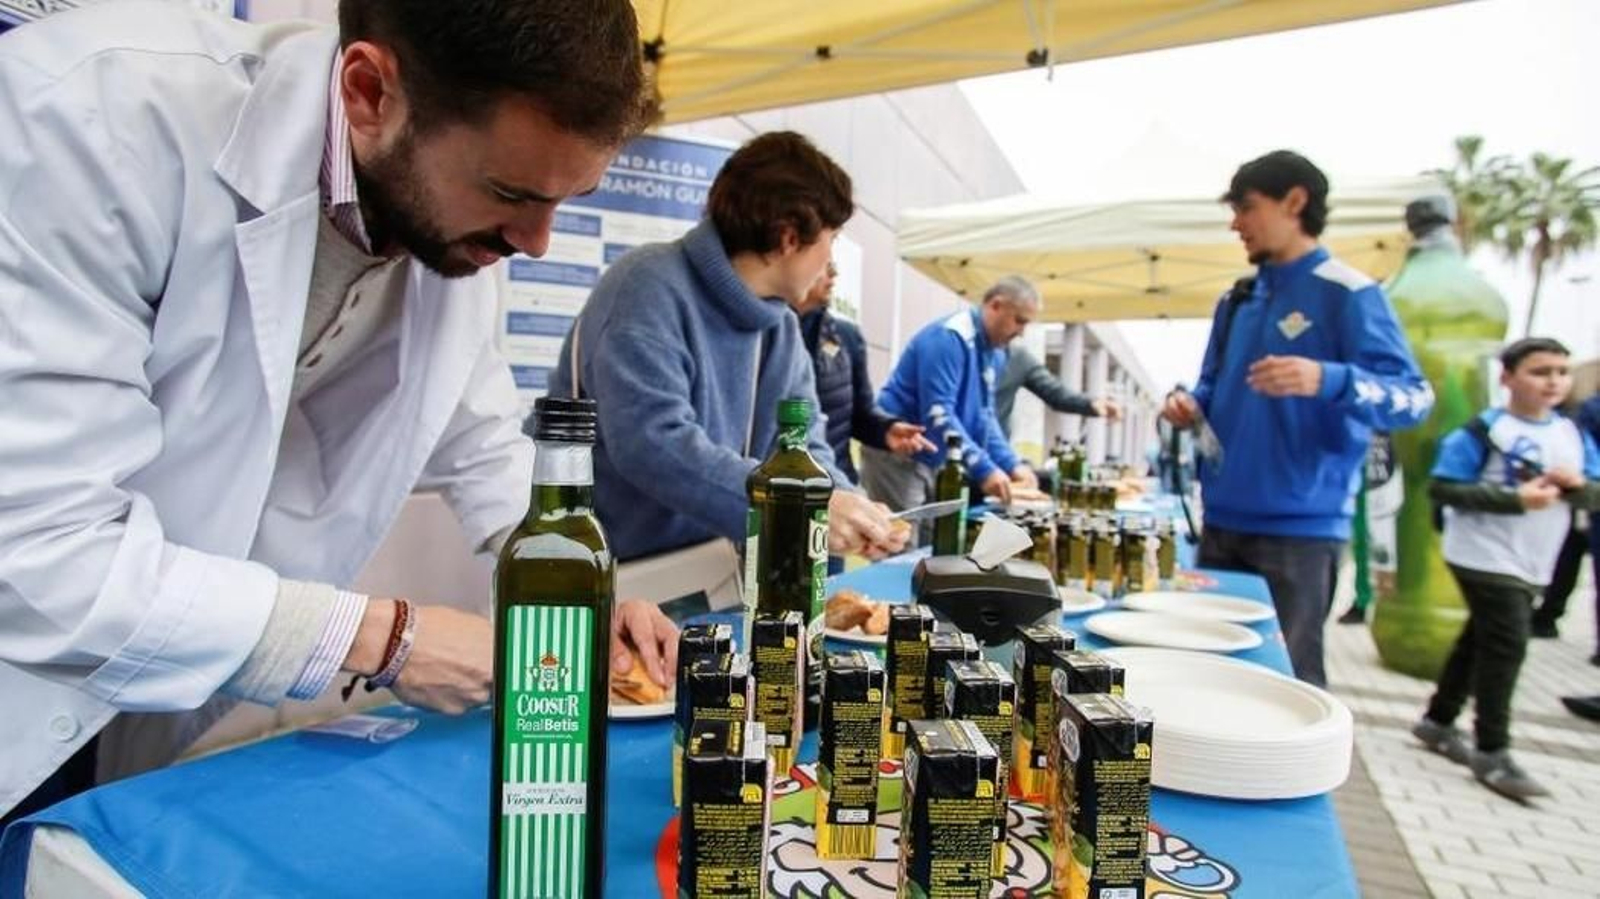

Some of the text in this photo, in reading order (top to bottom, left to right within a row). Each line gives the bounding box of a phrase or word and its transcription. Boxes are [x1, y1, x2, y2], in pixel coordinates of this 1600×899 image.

[517, 718, 579, 732] RealBetis
[506, 792, 584, 807] Virgen Extra
